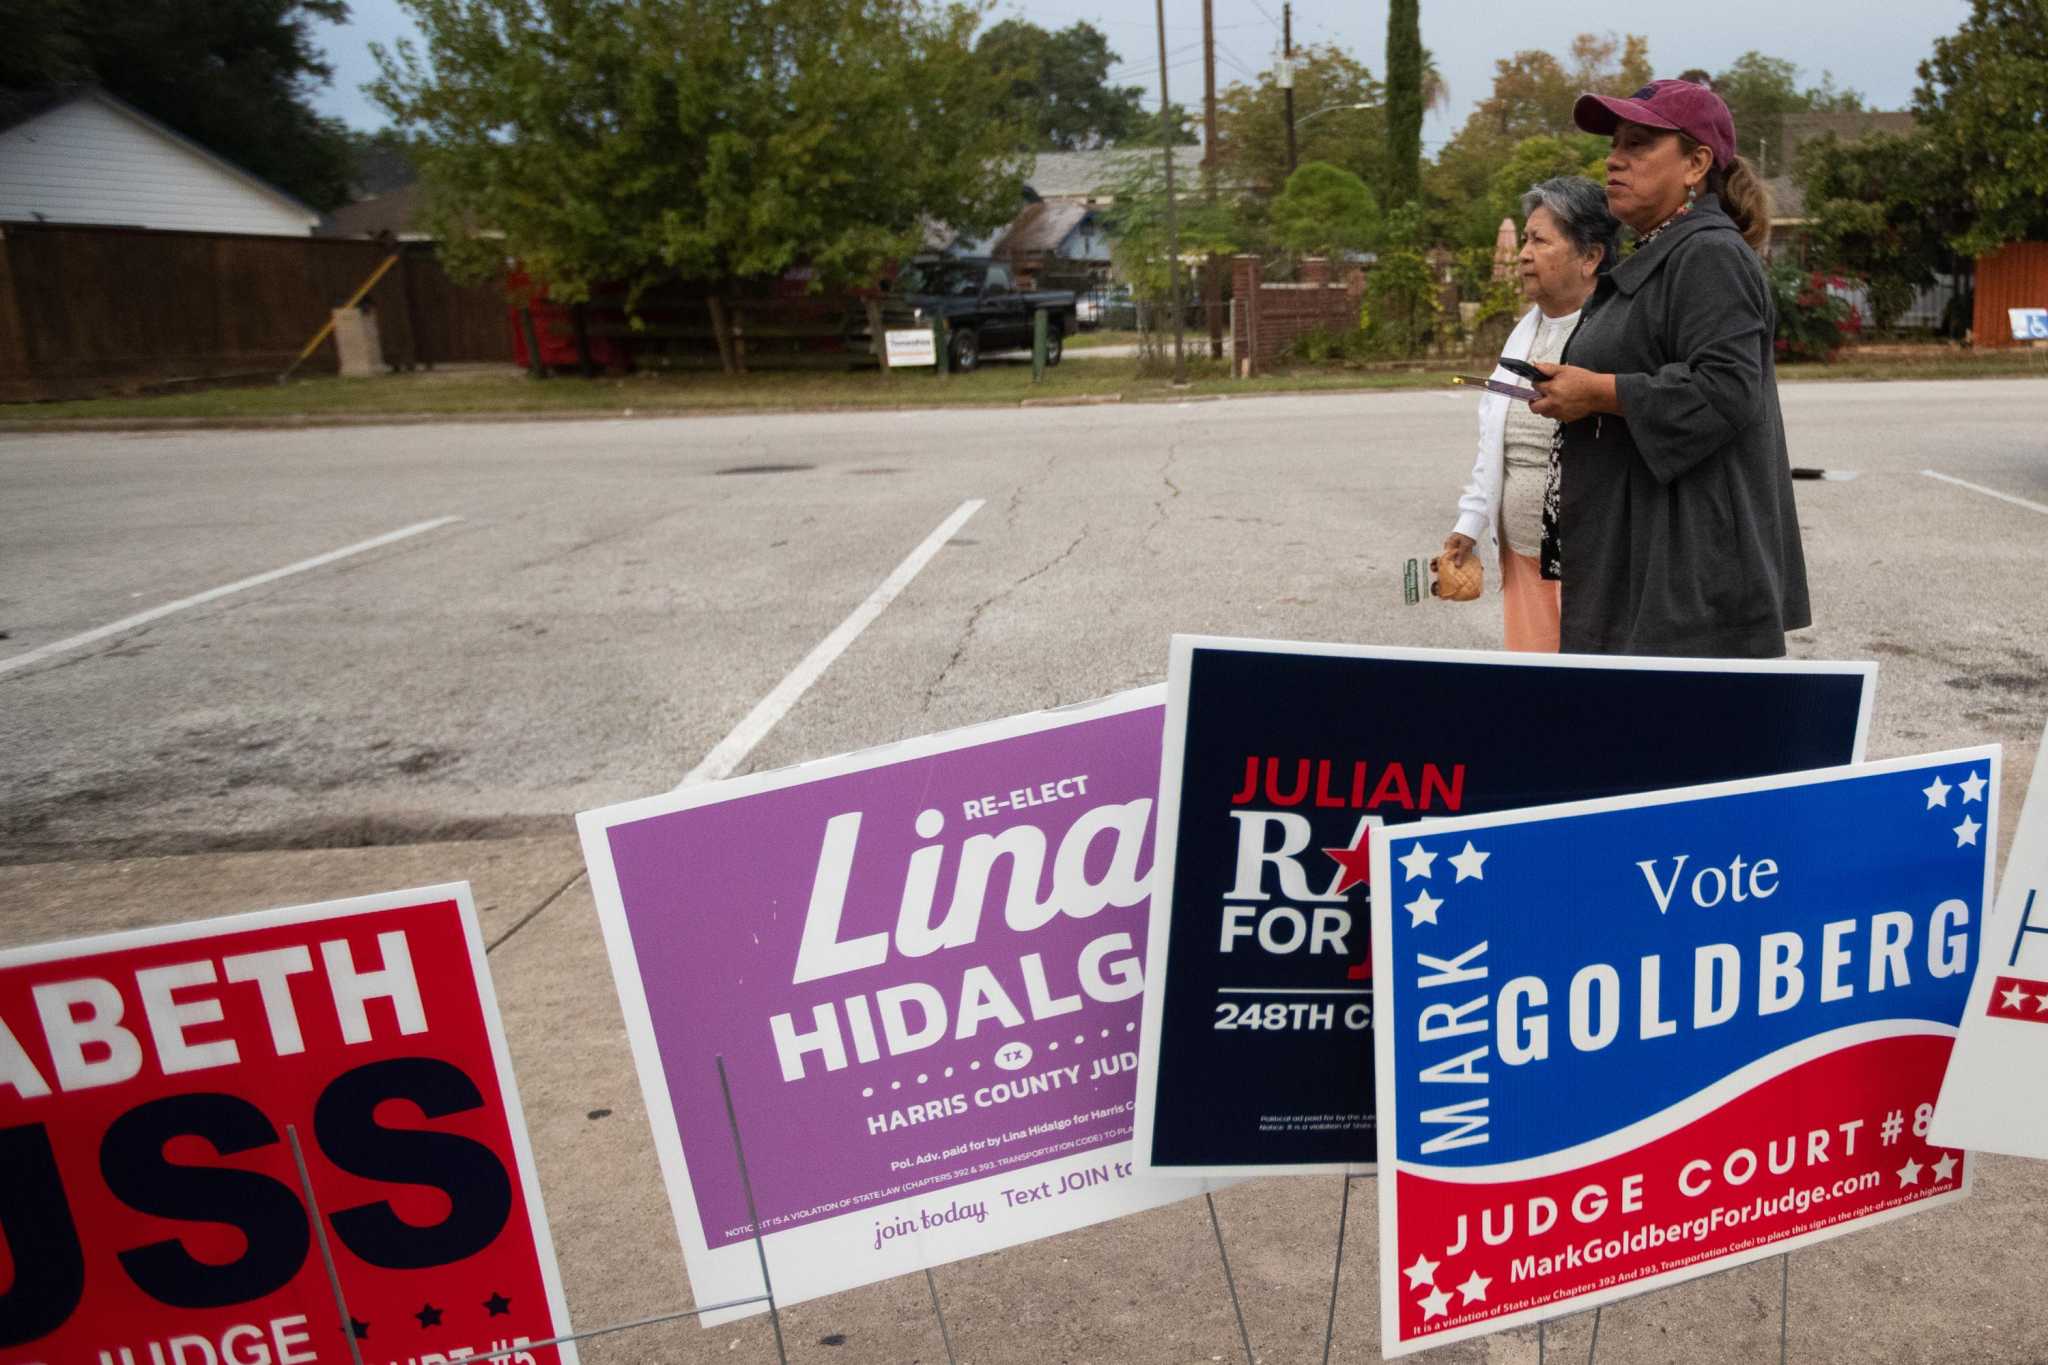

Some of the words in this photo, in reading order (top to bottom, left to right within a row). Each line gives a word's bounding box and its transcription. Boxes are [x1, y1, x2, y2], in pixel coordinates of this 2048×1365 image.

[962, 775, 1089, 821] RE-ELECT
[1231, 756, 1466, 810] JULIAN
[1222, 810, 1460, 902] RA
[1636, 854, 1780, 915] Vote
[792, 797, 1154, 985] Lina
[1219, 905, 1352, 955] FOR
[1496, 898, 1970, 1066] GOLDBERG
[1213, 1002, 1335, 1031] 248TH
[1344, 1003, 1375, 1030] C
[1416, 940, 1490, 1156] MARK
[1003, 1049, 1023, 1062] TX
[866, 1094, 969, 1136] HARRIS
[974, 1064, 1081, 1108] COUNTY
[1089, 1052, 1138, 1080] JUD
[891, 1157, 915, 1171] Pol.
[916, 1152, 941, 1165] Adv.
[942, 1144, 968, 1160] paid
[969, 1140, 986, 1151] for
[987, 1136, 1001, 1148] by
[1002, 1130, 1028, 1143] Lina
[1029, 1118, 1072, 1136] Hidalgo
[1073, 1113, 1089, 1125] for
[1090, 1104, 1125, 1121] Harris
[724, 1223, 762, 1237] NOTIC:
[763, 1219, 772, 1228] IT
[773, 1217, 782, 1225] IS
[790, 1202, 839, 1220] VIOLATION
[838, 1198, 851, 1208] OF
[852, 1191, 881, 1204] STATE
[881, 1186, 901, 1198] LAW
[902, 1172, 953, 1193] (CHAPTERS
[953, 1167, 969, 1179] 392
[970, 1166, 978, 1174] &
[998, 1141, 1075, 1165] TRANSPORTATION
[1104, 1129, 1117, 1139] TO
[1000, 1181, 1052, 1208] Text
[1057, 1164, 1110, 1195] JOIN
[1446, 1174, 1643, 1256] JUDGE
[1677, 1119, 1864, 1198] COURT
[874, 1217, 919, 1249] join
[921, 1201, 989, 1229] today
[1509, 1169, 1881, 1284] MarkGoldbergForJudge.com
[1413, 1325, 1422, 1336] It
[1423, 1322, 1432, 1333] is
[1442, 1309, 1489, 1328] violation
[1490, 1303, 1501, 1316] of
[1503, 1300, 1530, 1314] State
[1531, 1294, 1552, 1306] Law
[1553, 1281, 1597, 1299] Chapters
[1599, 1276, 1616, 1287] 392
[1618, 1269, 1638, 1283] And
[1639, 1264, 1659, 1278] 393,
[1660, 1245, 1729, 1271] Transportation
[1729, 1237, 1756, 1252] Code)
[1756, 1234, 1767, 1244] to
[1767, 1228, 1791, 1243] place
[1791, 1222, 1808, 1235] this
[1808, 1216, 1827, 1230] sign
[1828, 1213, 1837, 1224] in
[1837, 1210, 1852, 1222] the
[1852, 1197, 1903, 1220] right-of-way
[1902, 1191, 1913, 1202] of
[1919, 1182, 1953, 1199] highway
[99, 1314, 319, 1365] DGE
